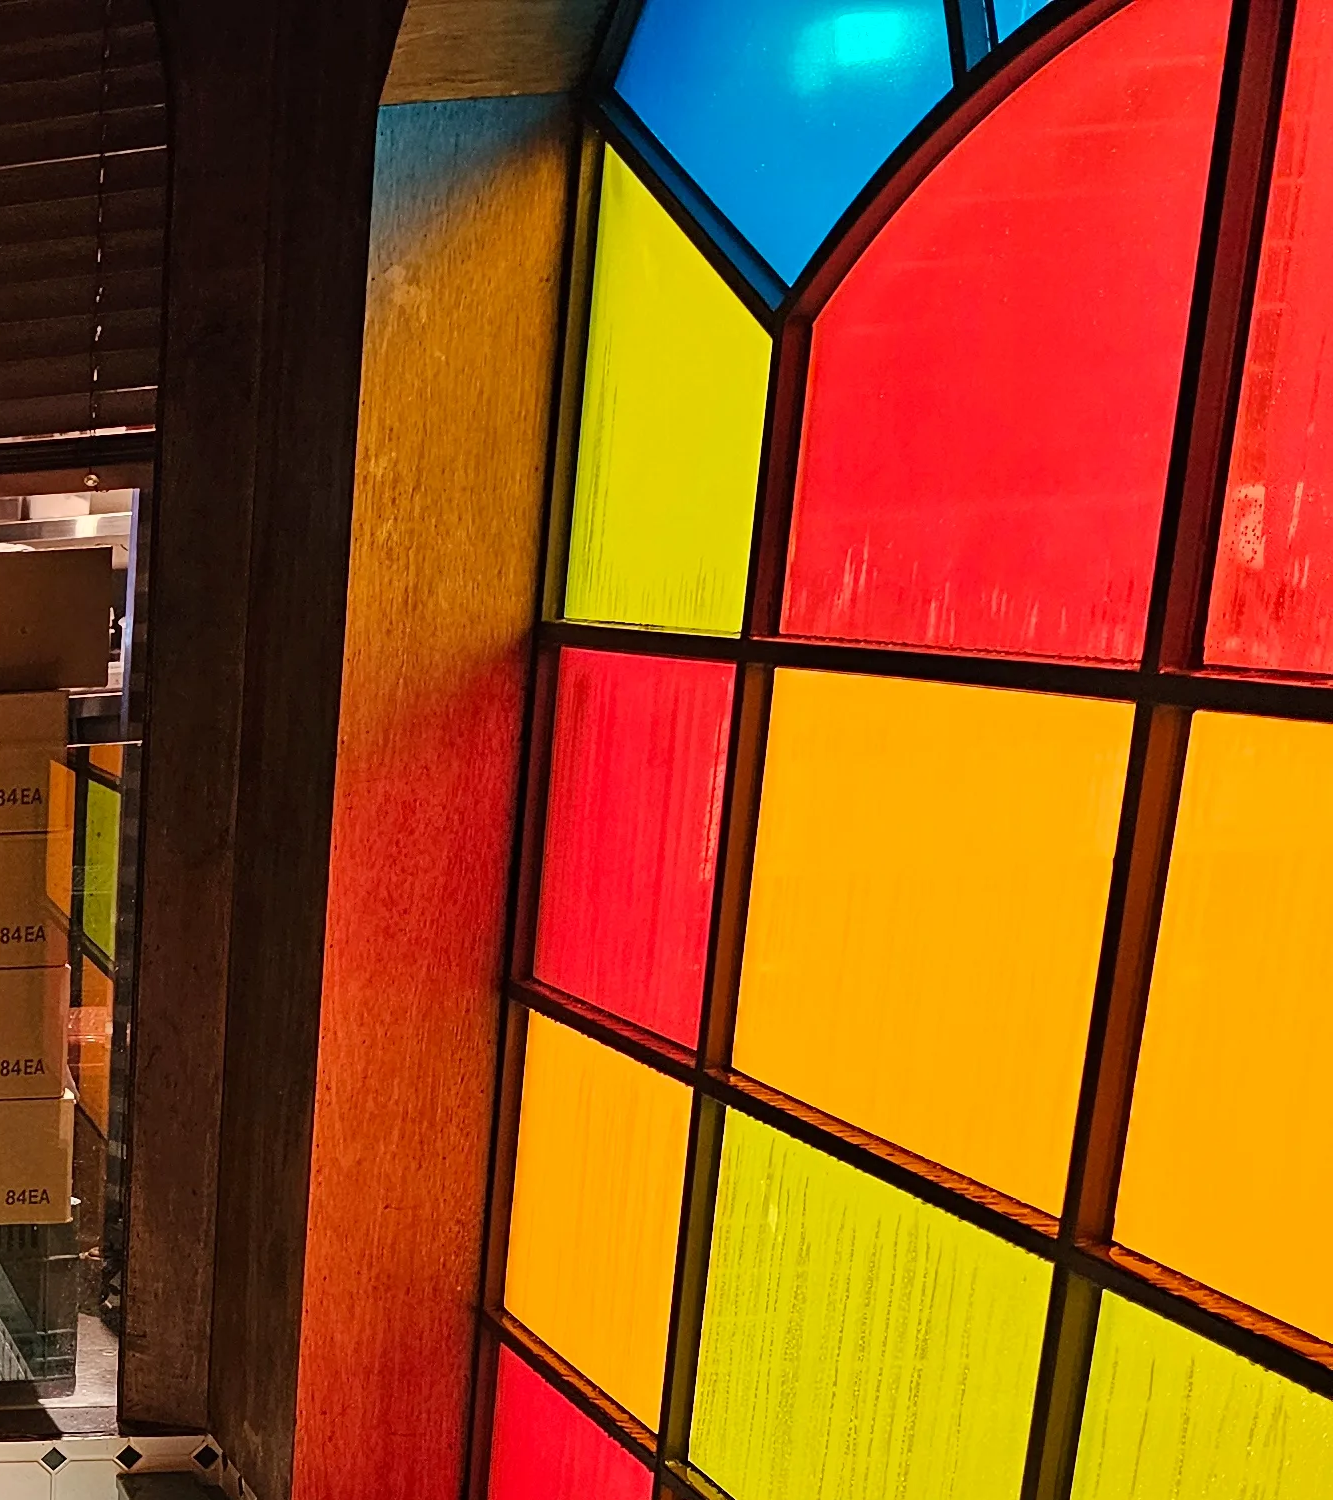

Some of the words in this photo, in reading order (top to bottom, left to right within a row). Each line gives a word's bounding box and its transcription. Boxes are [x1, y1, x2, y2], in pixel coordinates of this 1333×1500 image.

[0, 925, 47, 945] 84EA
[0, 1058, 46, 1077] 84EA
[5, 1189, 51, 1206] 84EA
